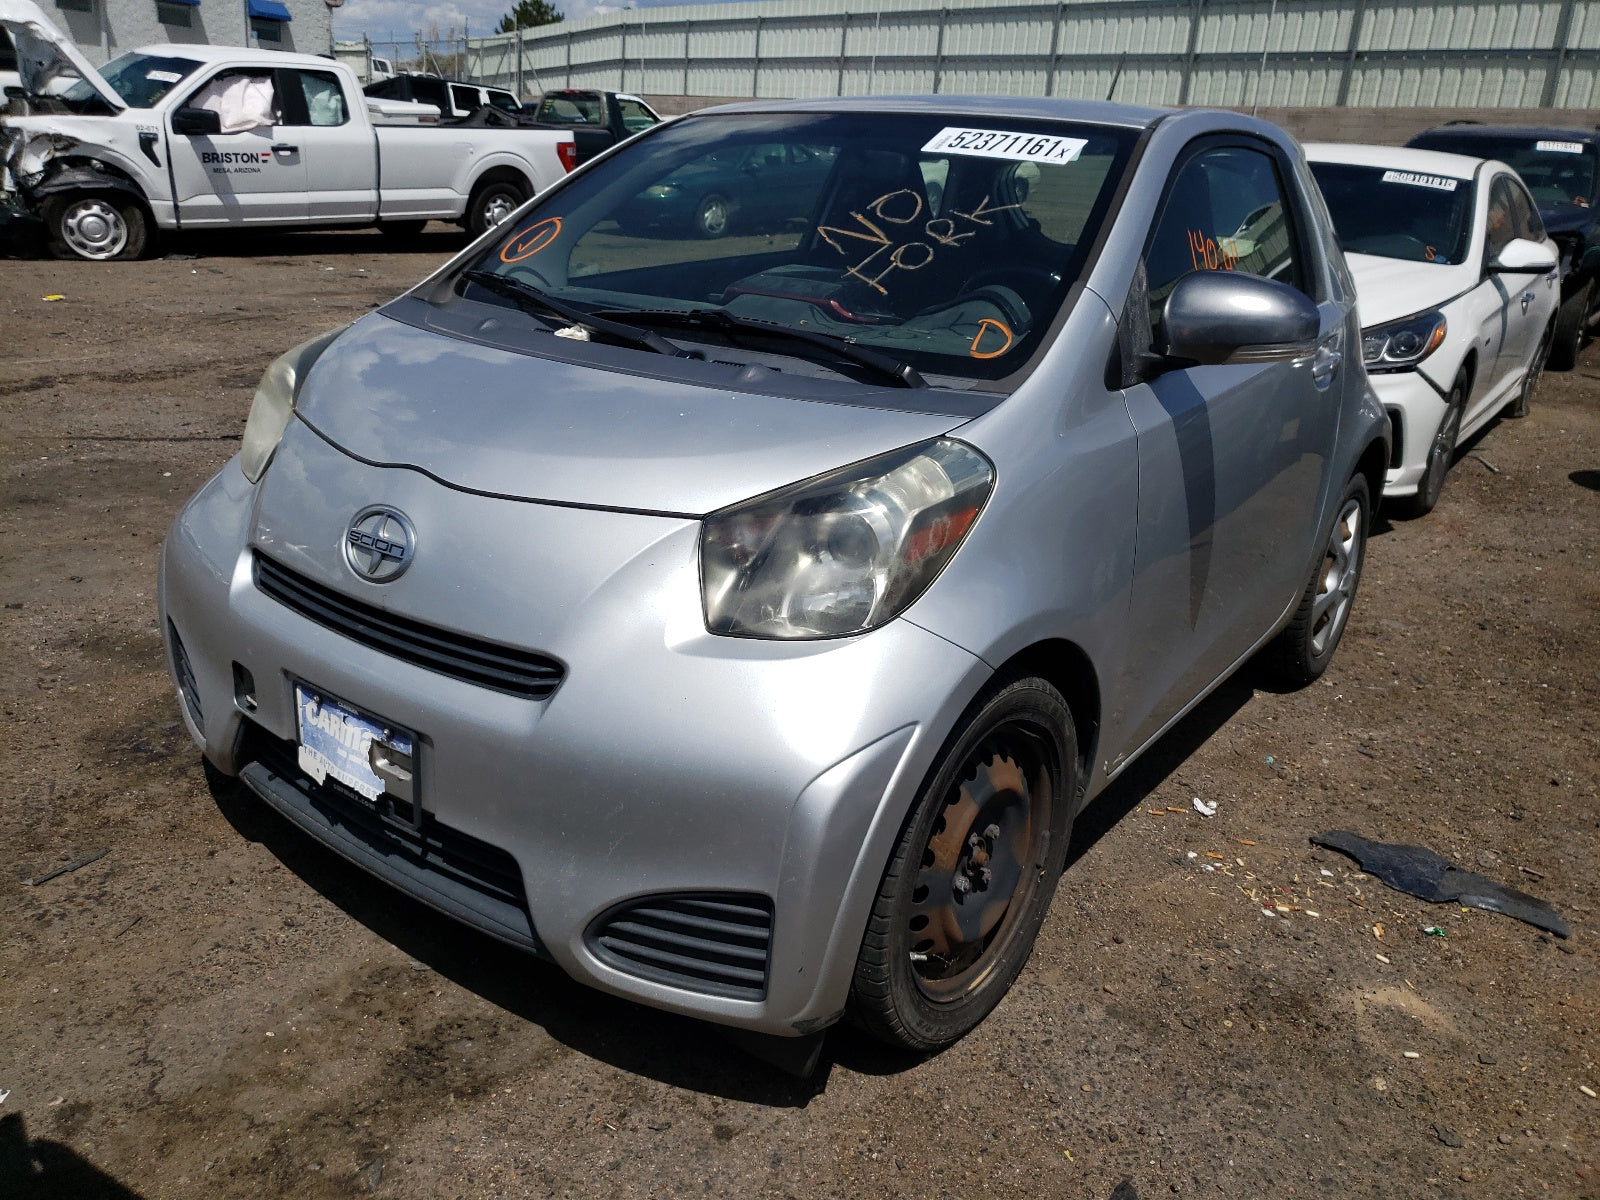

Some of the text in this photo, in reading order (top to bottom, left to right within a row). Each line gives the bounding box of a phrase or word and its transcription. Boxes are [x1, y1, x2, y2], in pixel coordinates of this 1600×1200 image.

[202, 152, 259, 164] BRISTON
[817, 189, 923, 255] NO
[969, 317, 1013, 359] D
[349, 530, 405, 557] SCION
[303, 745, 318, 759] THE
[337, 769, 378, 799] SUPERST
